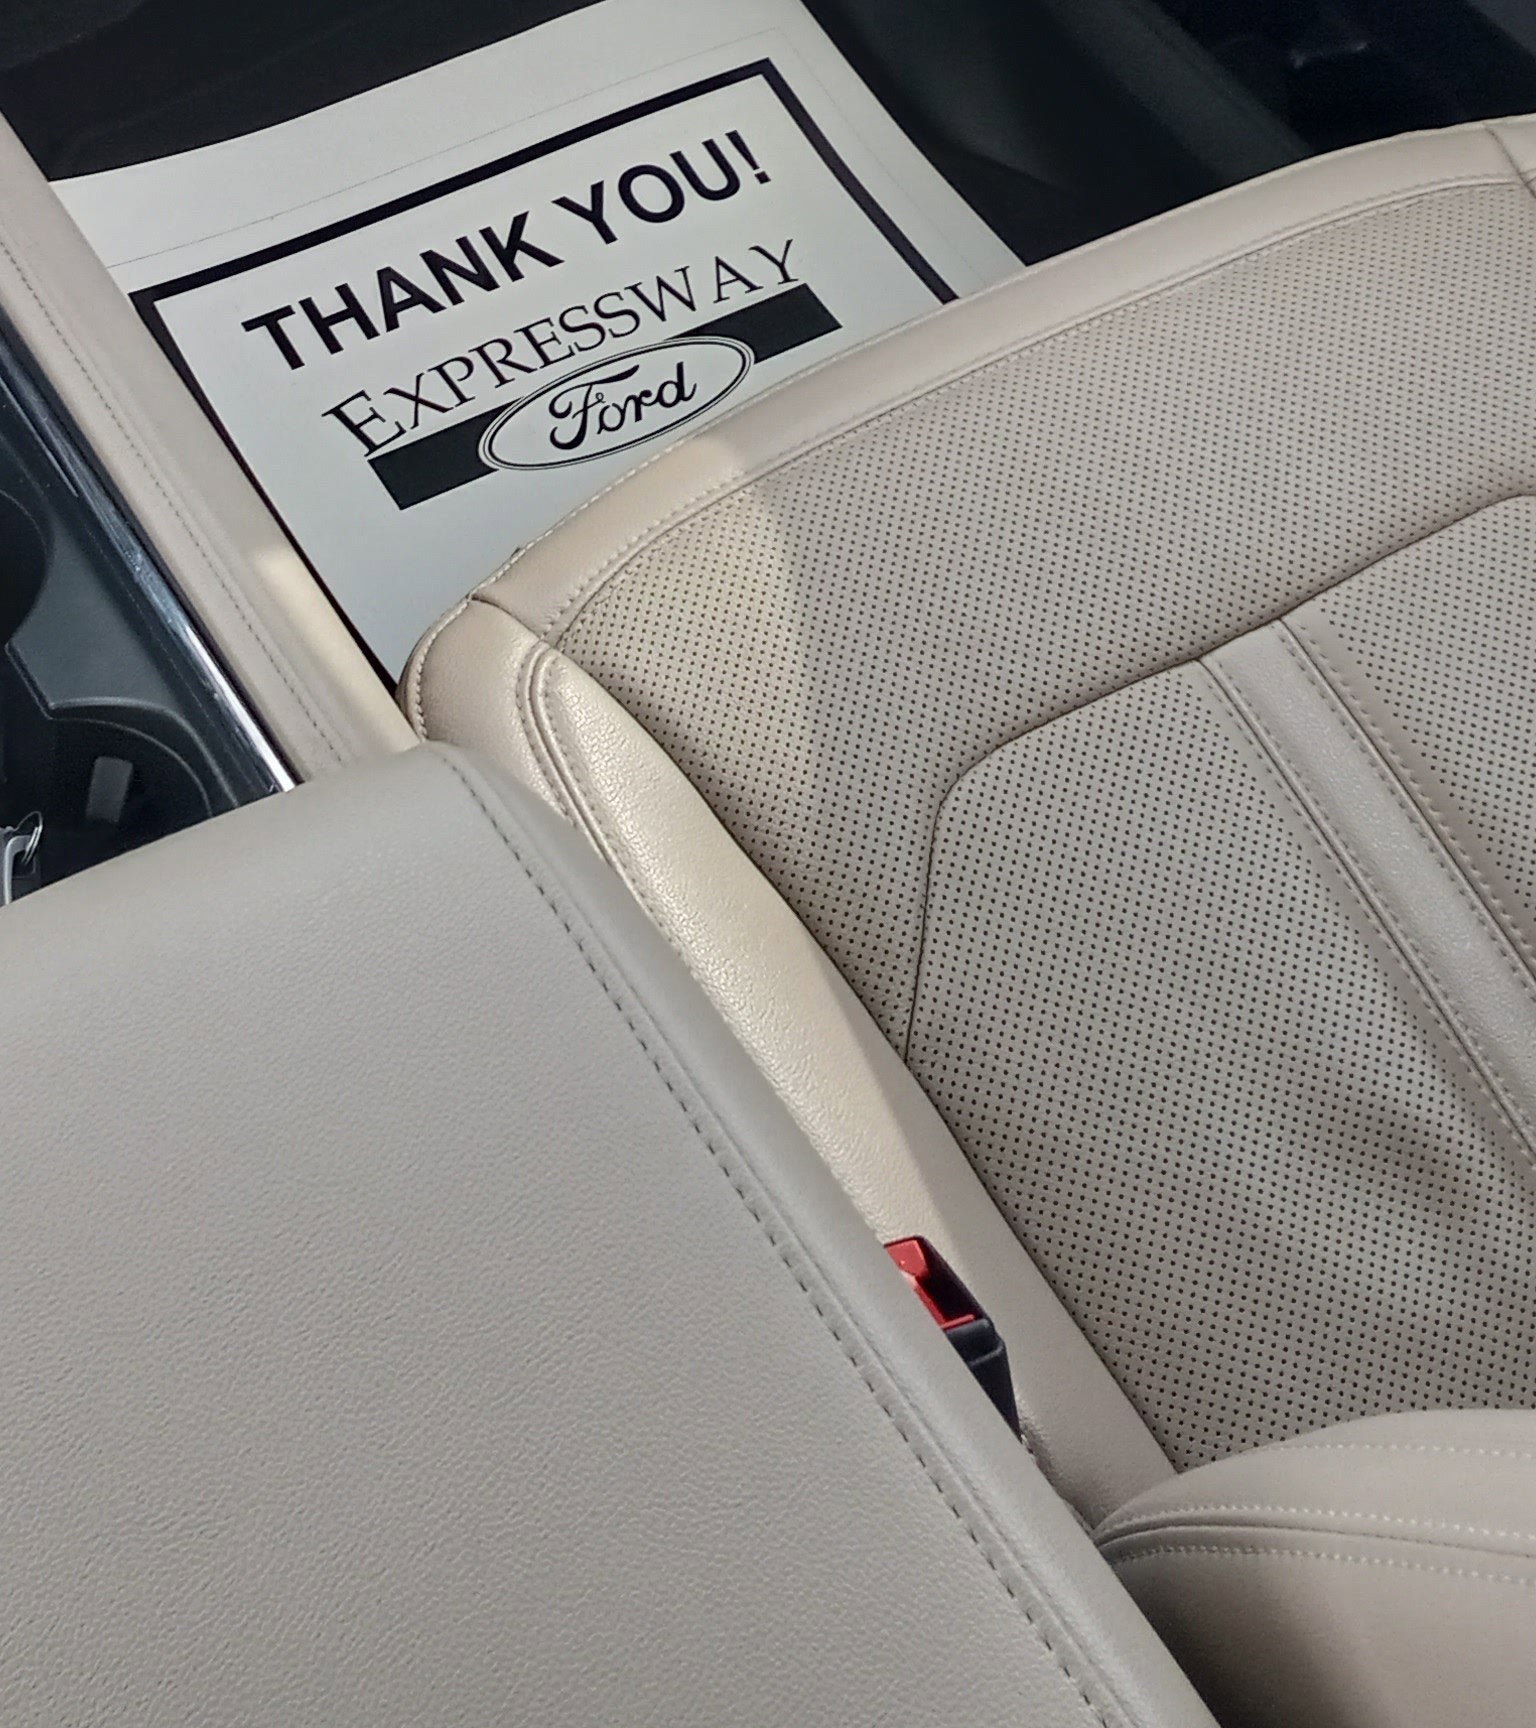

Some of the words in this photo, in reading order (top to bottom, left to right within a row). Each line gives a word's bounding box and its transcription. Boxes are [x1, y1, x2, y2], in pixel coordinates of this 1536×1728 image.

[242, 211, 562, 371] THANK
[552, 129, 772, 246] YOU!
[321, 238, 799, 458] EXPRESSWAY
[548, 360, 698, 451] Ford
